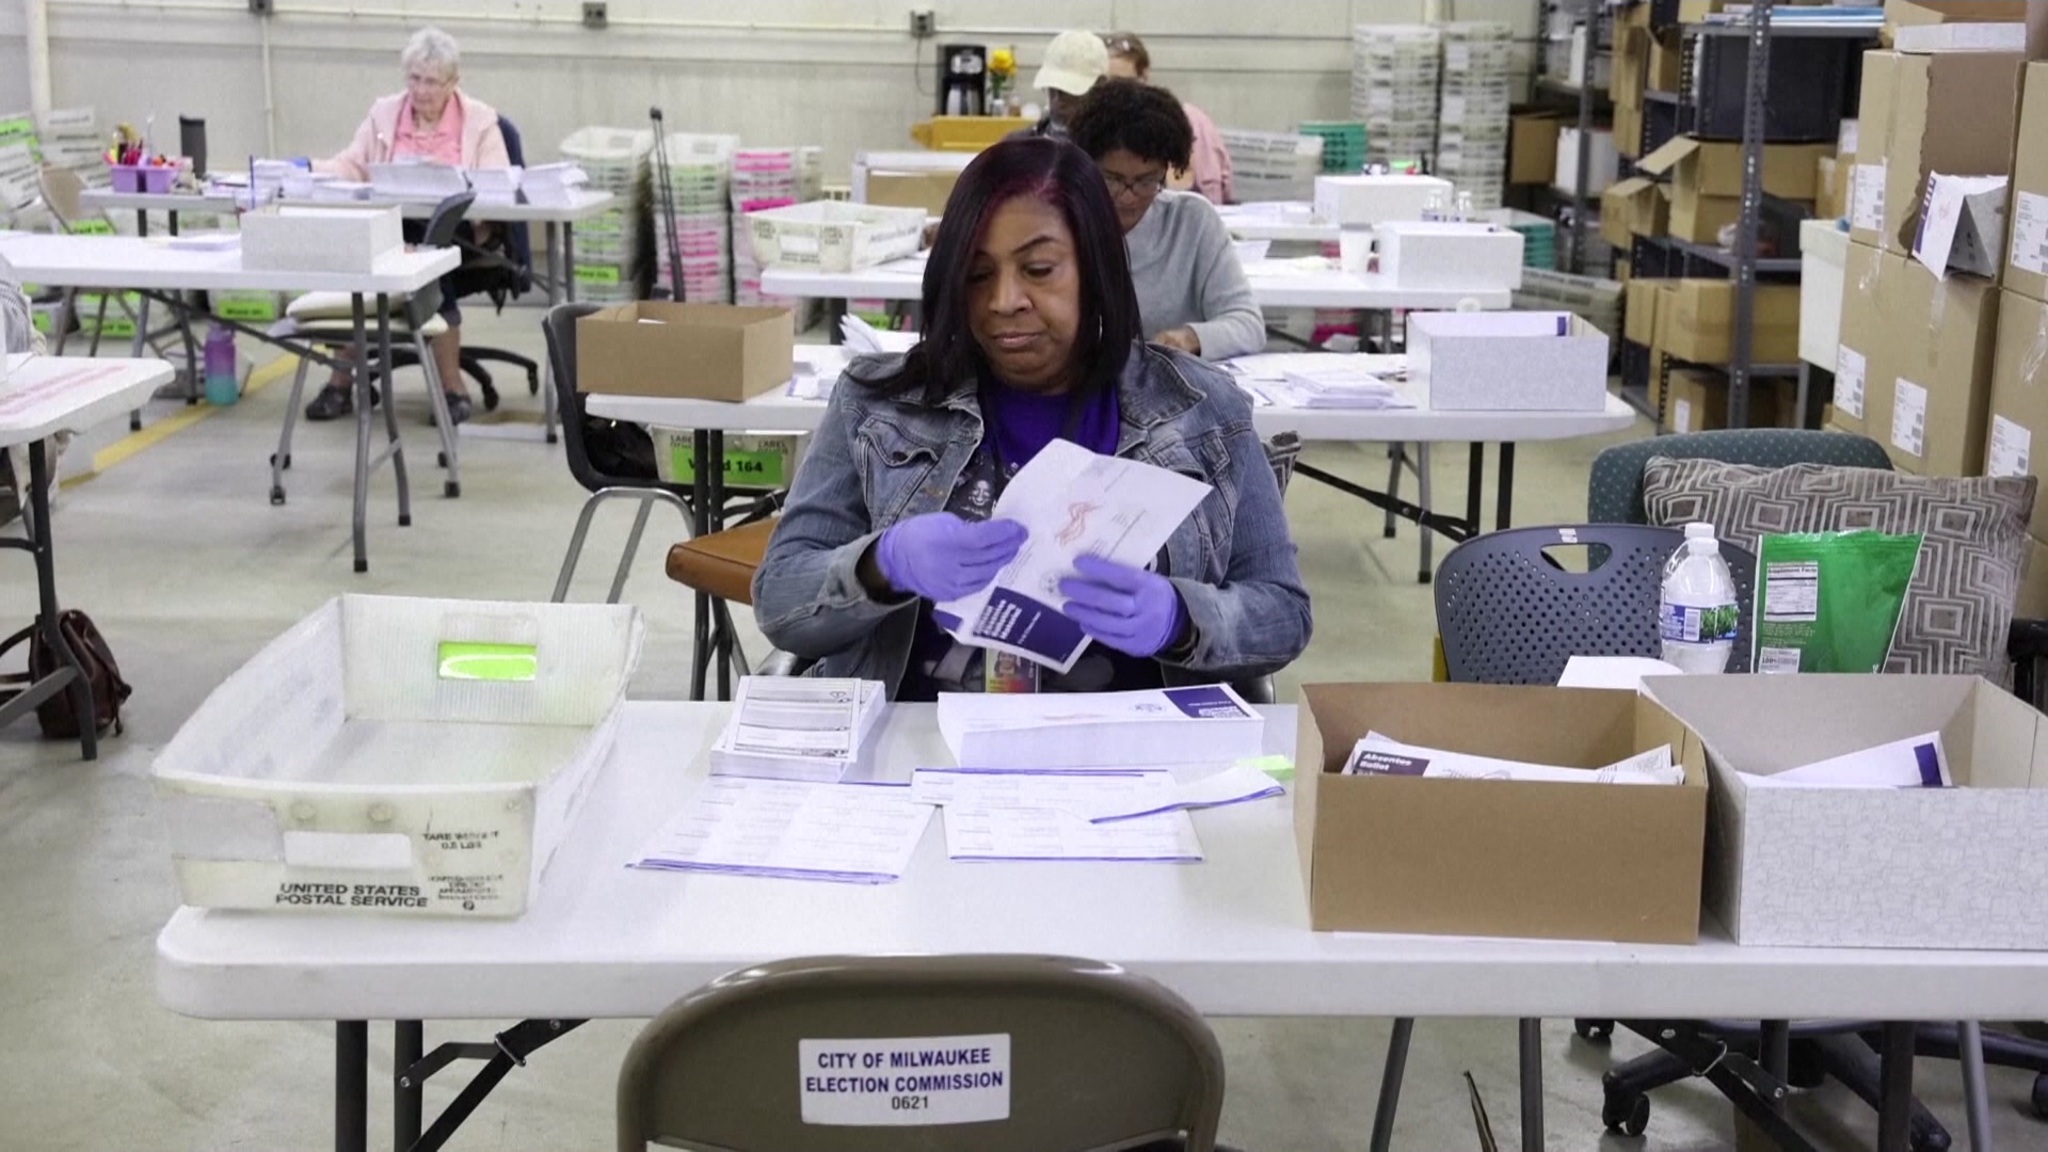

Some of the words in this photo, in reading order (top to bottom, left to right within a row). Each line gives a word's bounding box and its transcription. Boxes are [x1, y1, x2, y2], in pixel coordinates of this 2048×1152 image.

[737, 461, 763, 473] 164
[1363, 753, 1412, 766] Absentee
[280, 883, 348, 895] UNITED
[354, 885, 421, 897] STATES
[275, 894, 345, 906] POSTAL
[350, 895, 428, 908] SERVICE
[818, 1053, 856, 1068] CITY
[863, 1053, 884, 1068] OF
[890, 1048, 991, 1068] MILWAUKEE
[806, 1077, 889, 1092] ELECTION
[895, 1071, 1003, 1091] COMMISSION
[892, 1096, 928, 1109] 0621
